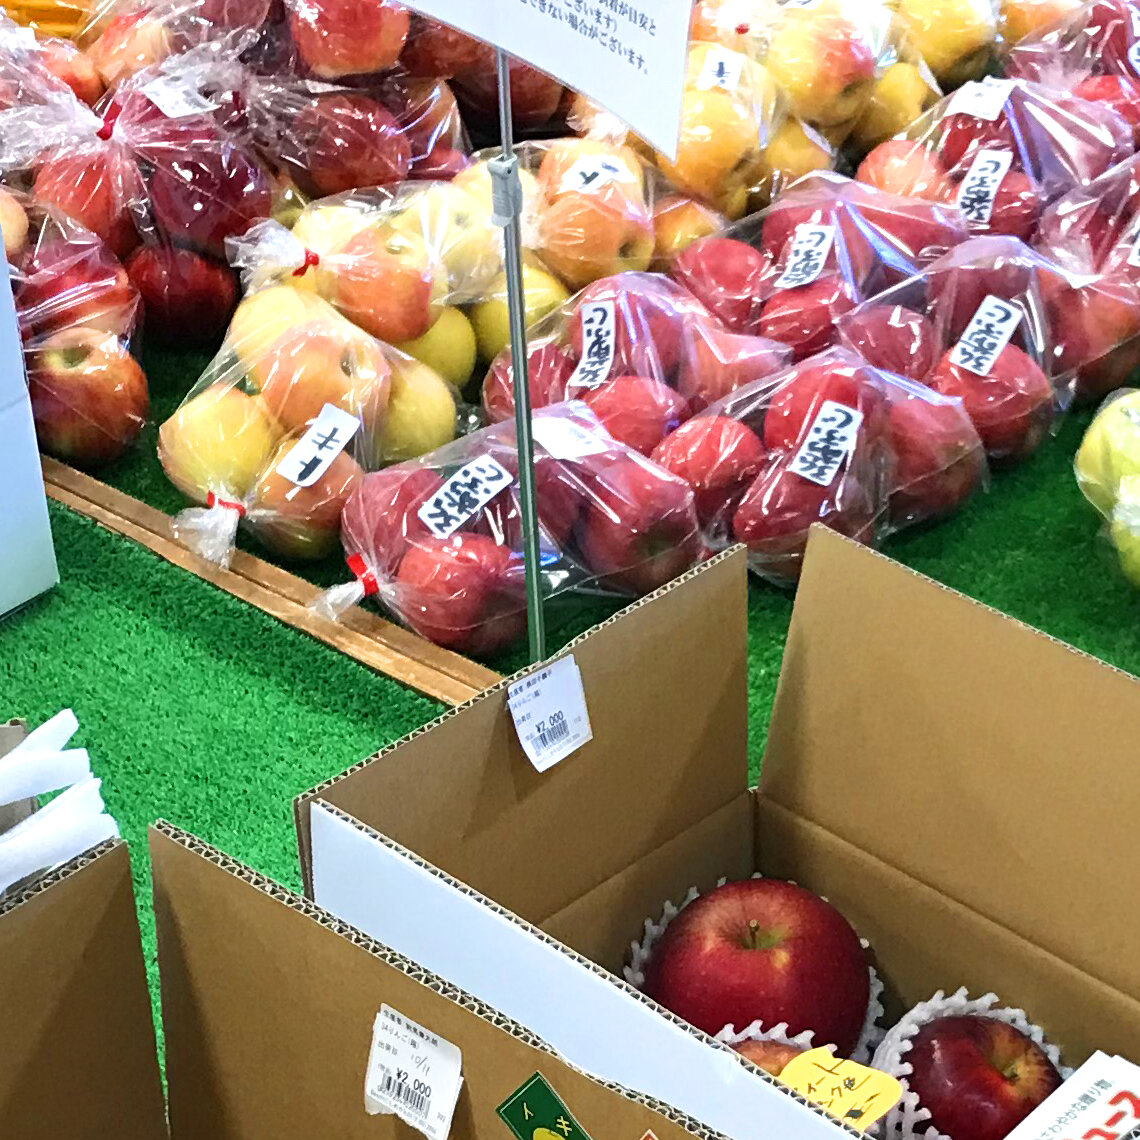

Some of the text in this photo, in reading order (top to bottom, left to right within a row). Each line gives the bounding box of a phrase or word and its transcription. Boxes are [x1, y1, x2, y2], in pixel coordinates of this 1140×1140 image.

[578, 307, 611, 382] 弘前ふじ
[960, 304, 1012, 372] 弘前ふじ
[798, 407, 854, 482] 弘前ふじ
[427, 463, 504, 534] 弘前ふじ
